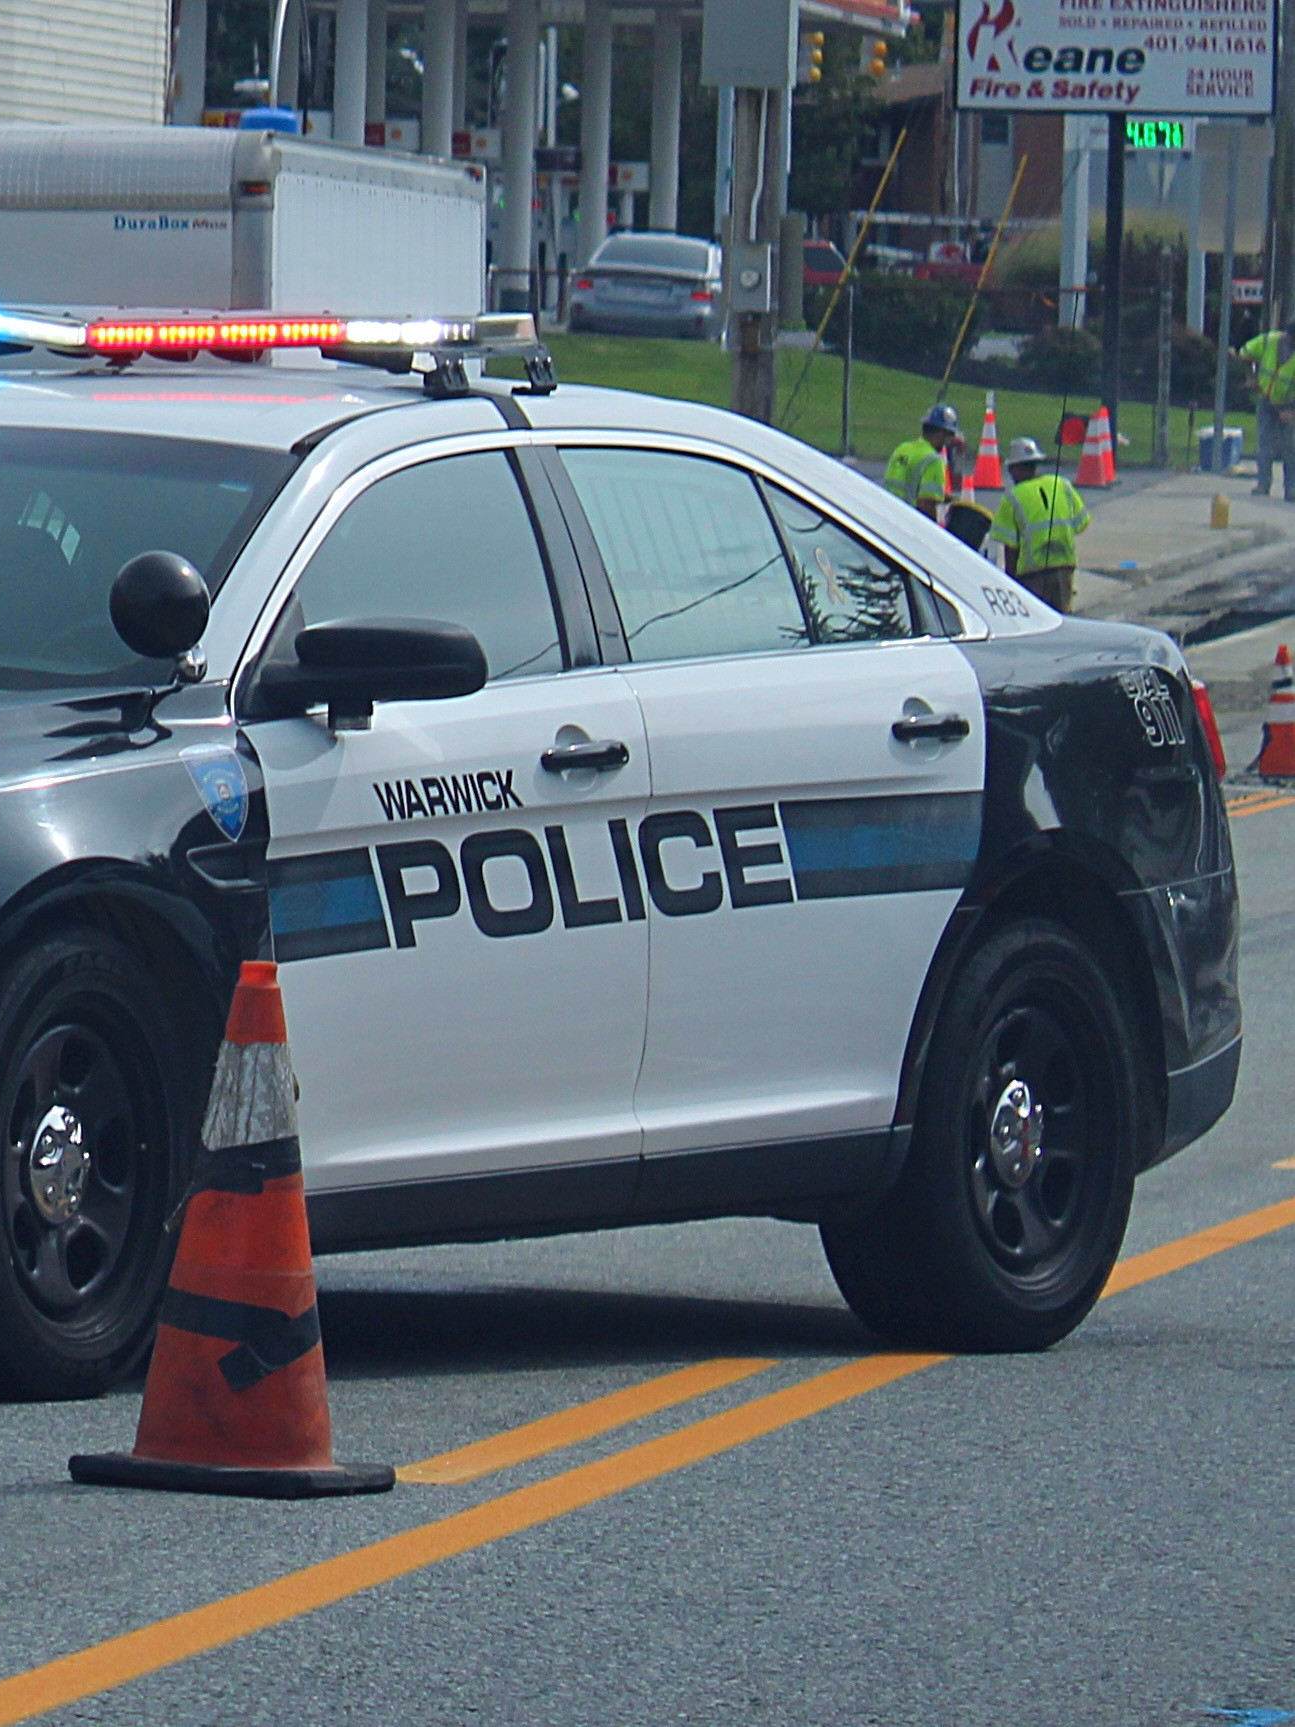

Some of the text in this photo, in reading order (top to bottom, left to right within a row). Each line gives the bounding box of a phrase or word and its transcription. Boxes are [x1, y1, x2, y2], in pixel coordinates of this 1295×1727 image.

[1059, 17, 1267, 32] SOLD REPAIRED REFILLED
[1144, 34, 1267, 54] 401.941.1616
[1210, 68, 1253, 81] HOUR
[969, 77, 1140, 105] Fire & Safety
[1186, 81, 1254, 97] SERVICE
[113, 214, 190, 231] DuraBox
[981, 585, 1031, 619] R83
[1133, 695, 1187, 748] 911
[373, 769, 525, 822] WARWICK
[375, 802, 795, 950] POLICE
